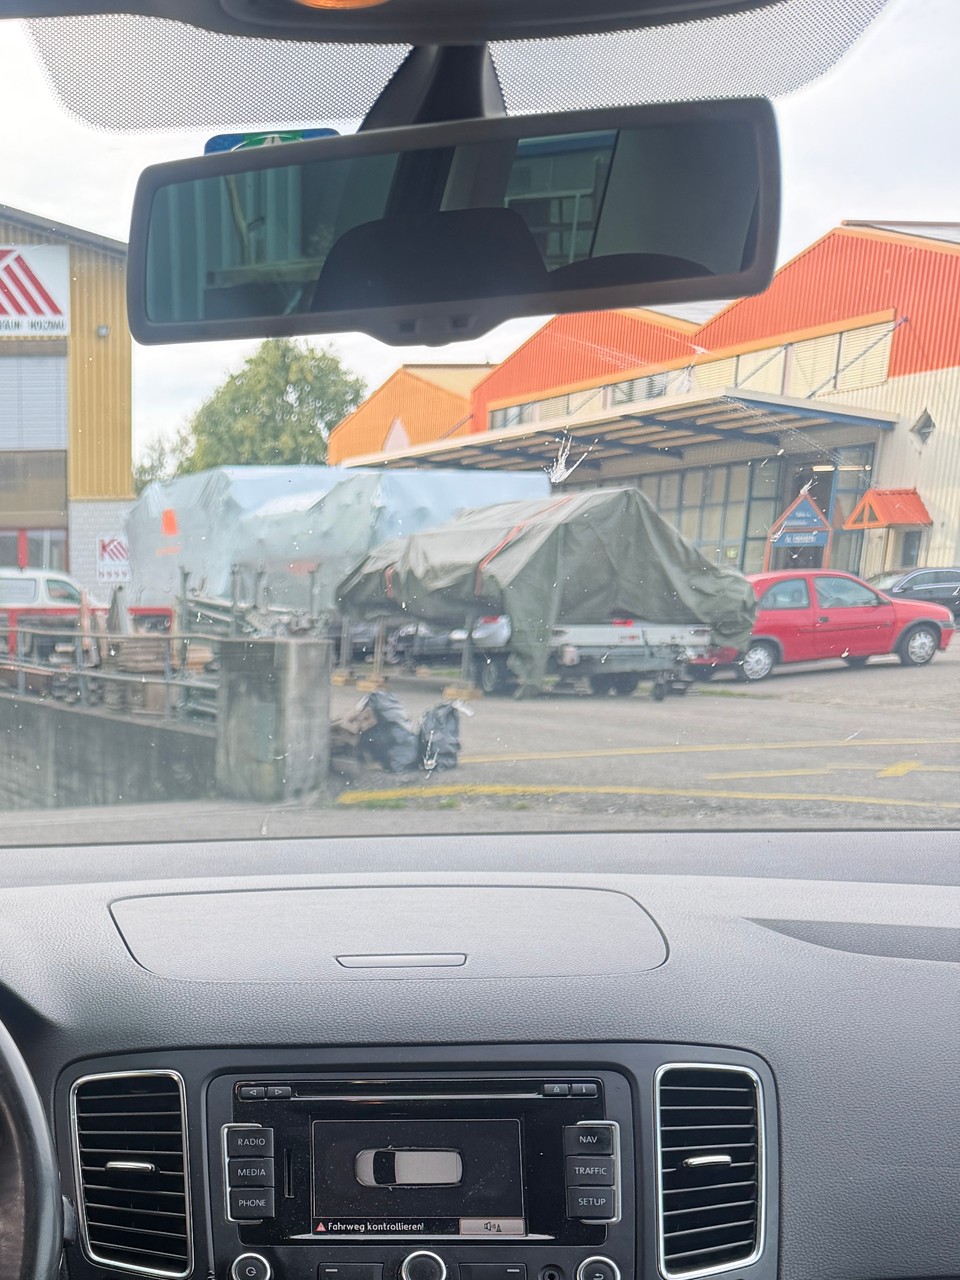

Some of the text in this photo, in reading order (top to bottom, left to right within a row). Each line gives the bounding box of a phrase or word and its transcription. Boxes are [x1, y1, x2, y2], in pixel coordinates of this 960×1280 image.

[237, 1138, 266, 1146] RADIO
[579, 1135, 598, 1143] NAV
[237, 1168, 266, 1176] MEDIA
[574, 1167, 607, 1175] TRAFFIC
[238, 1199, 266, 1207] PHONE
[578, 1198, 606, 1206] SETUP
[328, 1221, 425, 1233] Fahrweg kontrollieren!
